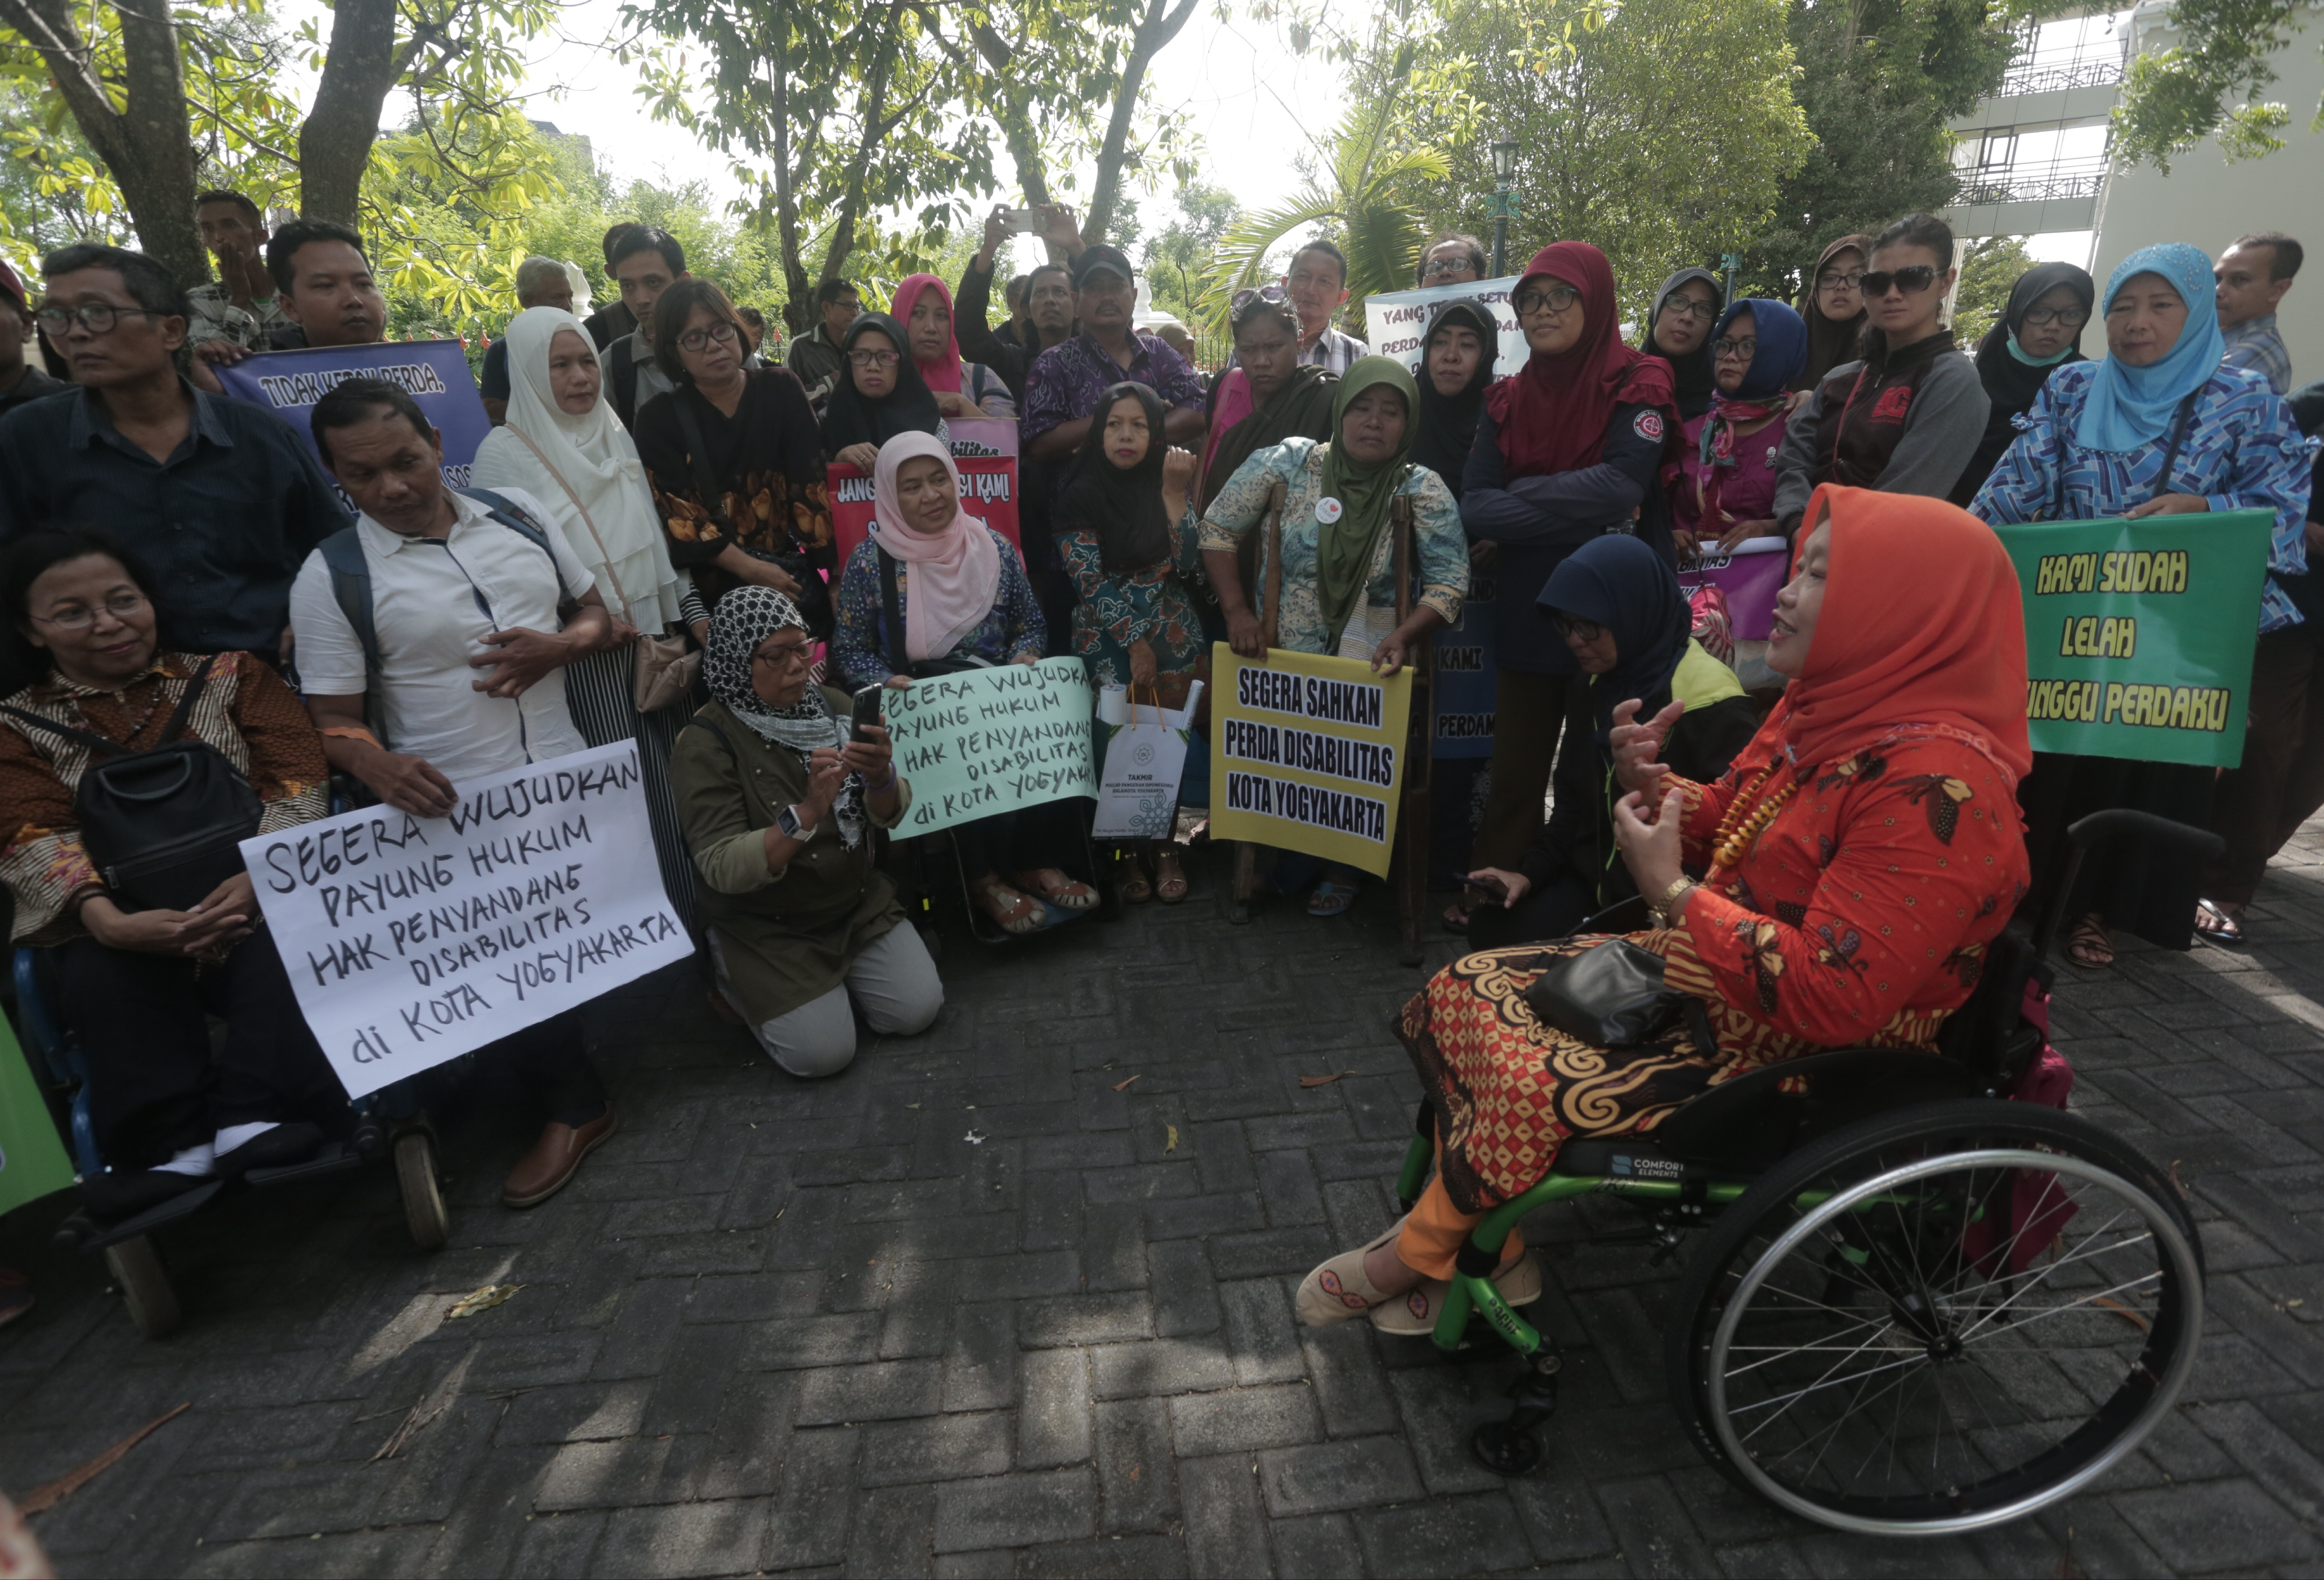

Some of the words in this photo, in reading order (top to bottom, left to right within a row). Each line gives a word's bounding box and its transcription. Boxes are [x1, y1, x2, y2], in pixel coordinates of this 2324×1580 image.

[1383, 305, 1425, 325] YANG
[260, 374, 322, 407] TIDAK
[976, 473, 1009, 504] KAMI
[2036, 552, 2098, 595] KAMI
[2099, 550, 2189, 594] SUDAH
[1439, 647, 1482, 670] KAMI
[2059, 616, 2137, 658] LELAH
[979, 691, 1061, 720] HUKUM
[1239, 667, 1303, 714] SEGERA
[1306, 677, 1382, 728] SAHKAN
[2102, 682, 2231, 732] PERDAKU
[904, 742, 948, 773] HAK
[957, 718, 1090, 761] PENYANDANG
[967, 740, 1088, 781] DISABILITAS
[1226, 719, 1280, 764] PERDA
[1284, 729, 1393, 787] DISABILITAS
[266, 814, 428, 894] SEGERA
[448, 749, 639, 835] WUJUDKAN
[914, 802, 936, 825] di
[942, 782, 999, 817] KOTA
[1228, 772, 1272, 815] KOTA
[1275, 780, 1386, 843] YOGYAKARTA
[320, 853, 454, 928] PAYUNG
[467, 814, 592, 878] HUKUM
[307, 934, 390, 986] HAK
[388, 863, 583, 956] PENYANDANG
[410, 898, 592, 987] DISABILITAS
[352, 1024, 392, 1064] di
[400, 982, 492, 1042] KOTA
[497, 911, 678, 1001] YOGYAKARTA
[1634, 1158, 1684, 1172] COMFORT
[1639, 1169, 1679, 1178] ELEMENTS
